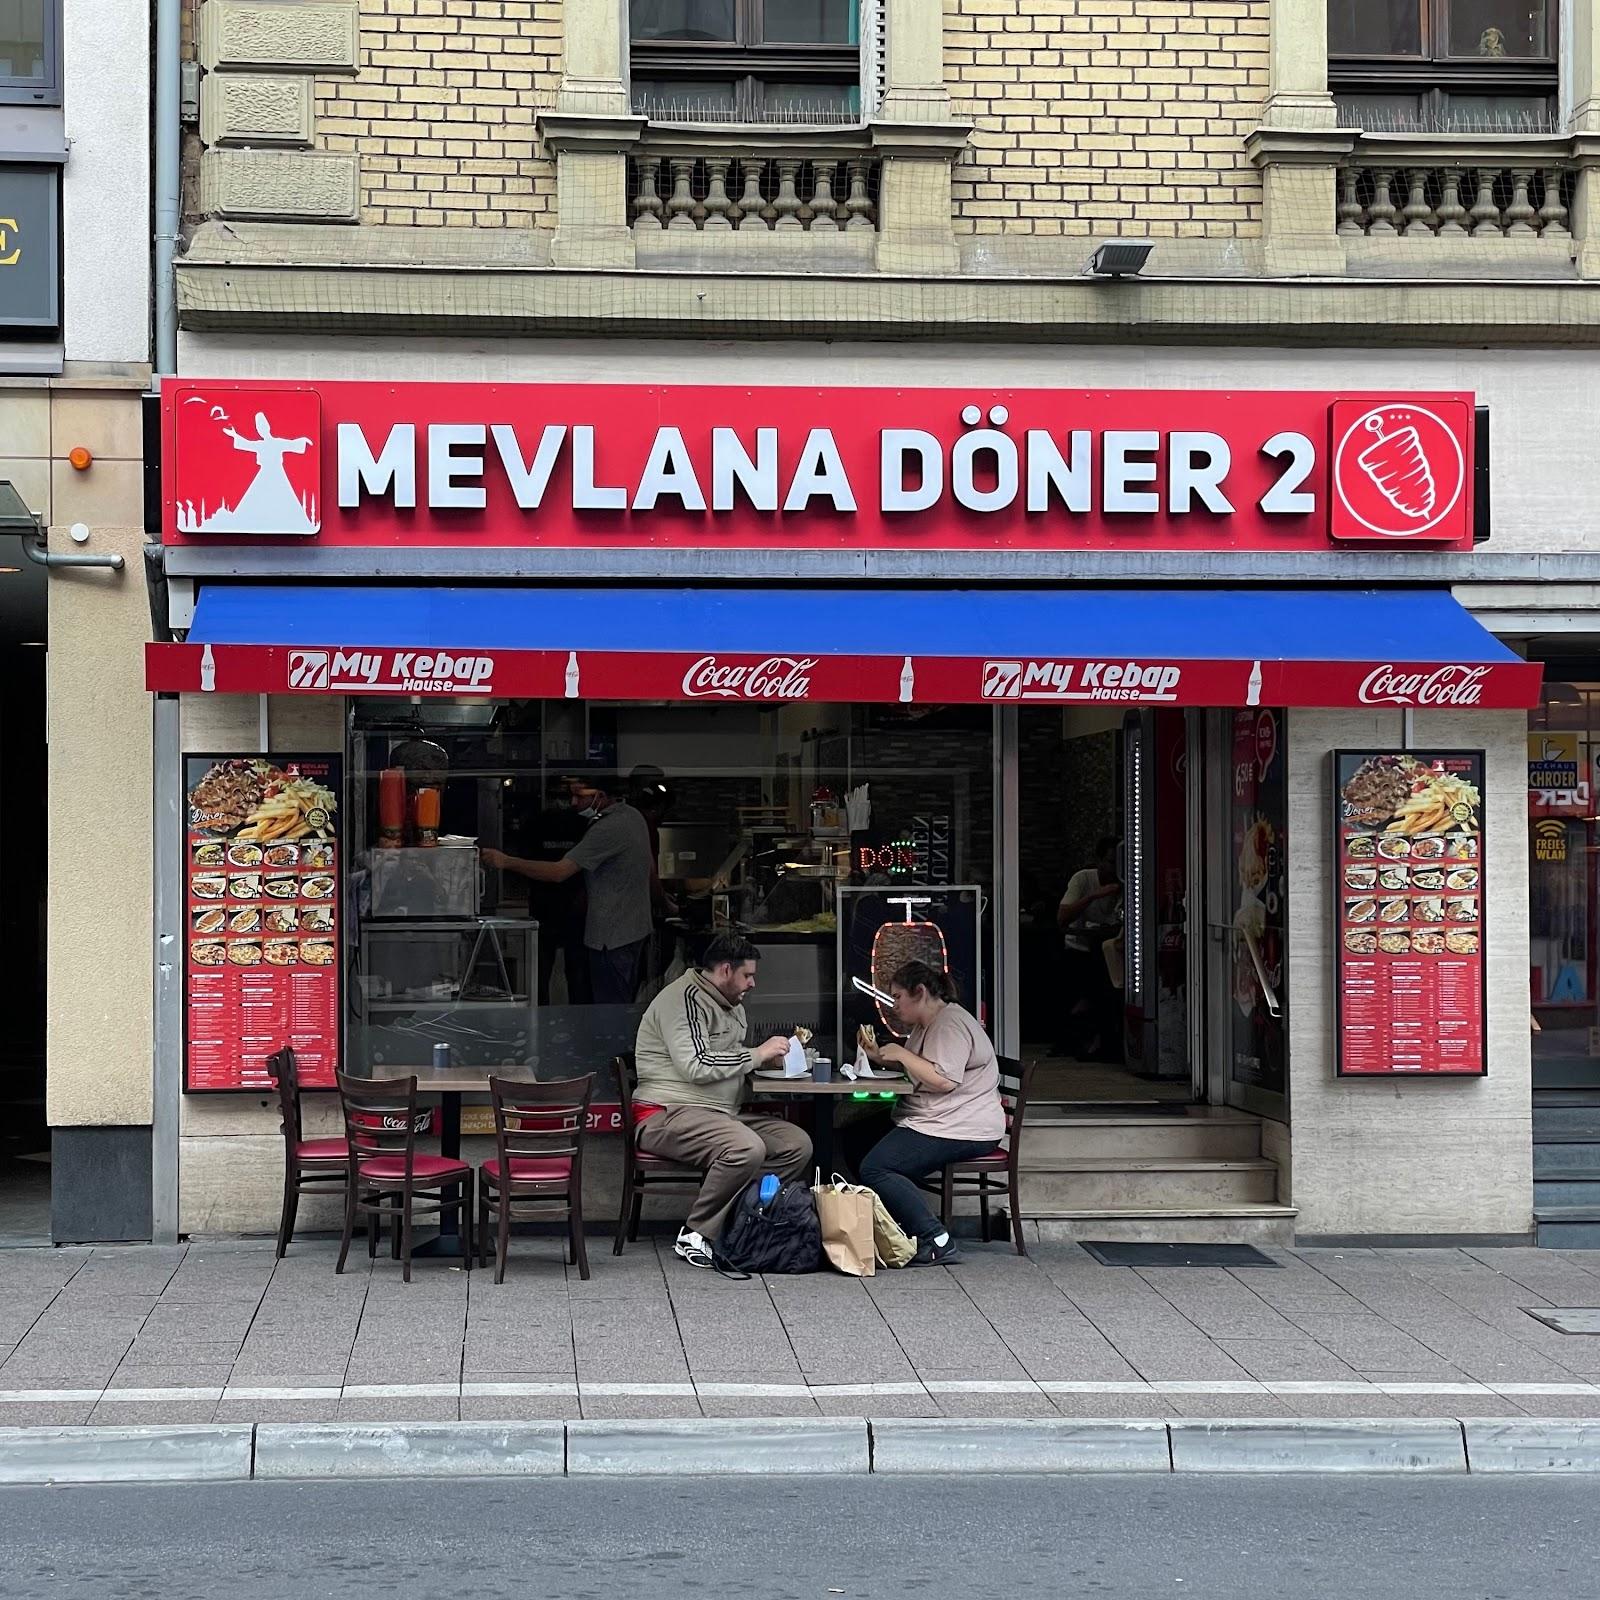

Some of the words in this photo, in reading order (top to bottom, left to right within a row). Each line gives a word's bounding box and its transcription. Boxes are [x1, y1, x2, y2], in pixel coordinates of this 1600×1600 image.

[337, 422, 857, 511] MEVLANA
[880, 404, 1237, 513] DÖNER
[1257, 432, 1316, 513] 2
[330, 651, 382, 684] My
[391, 652, 494, 686] Kebap
[681, 656, 819, 698] Coca-Cola
[1022, 661, 1074, 693] My
[1080, 662, 1181, 695] Kebap
[401, 678, 453, 692] House
[1090, 687, 1140, 701] House
[1358, 664, 1494, 705] Coca-Cola
[1530, 762, 1576, 770] ACKHAUS
[1536, 839, 1566, 850] FREIES
[1536, 849, 1566, 860] WLAN
